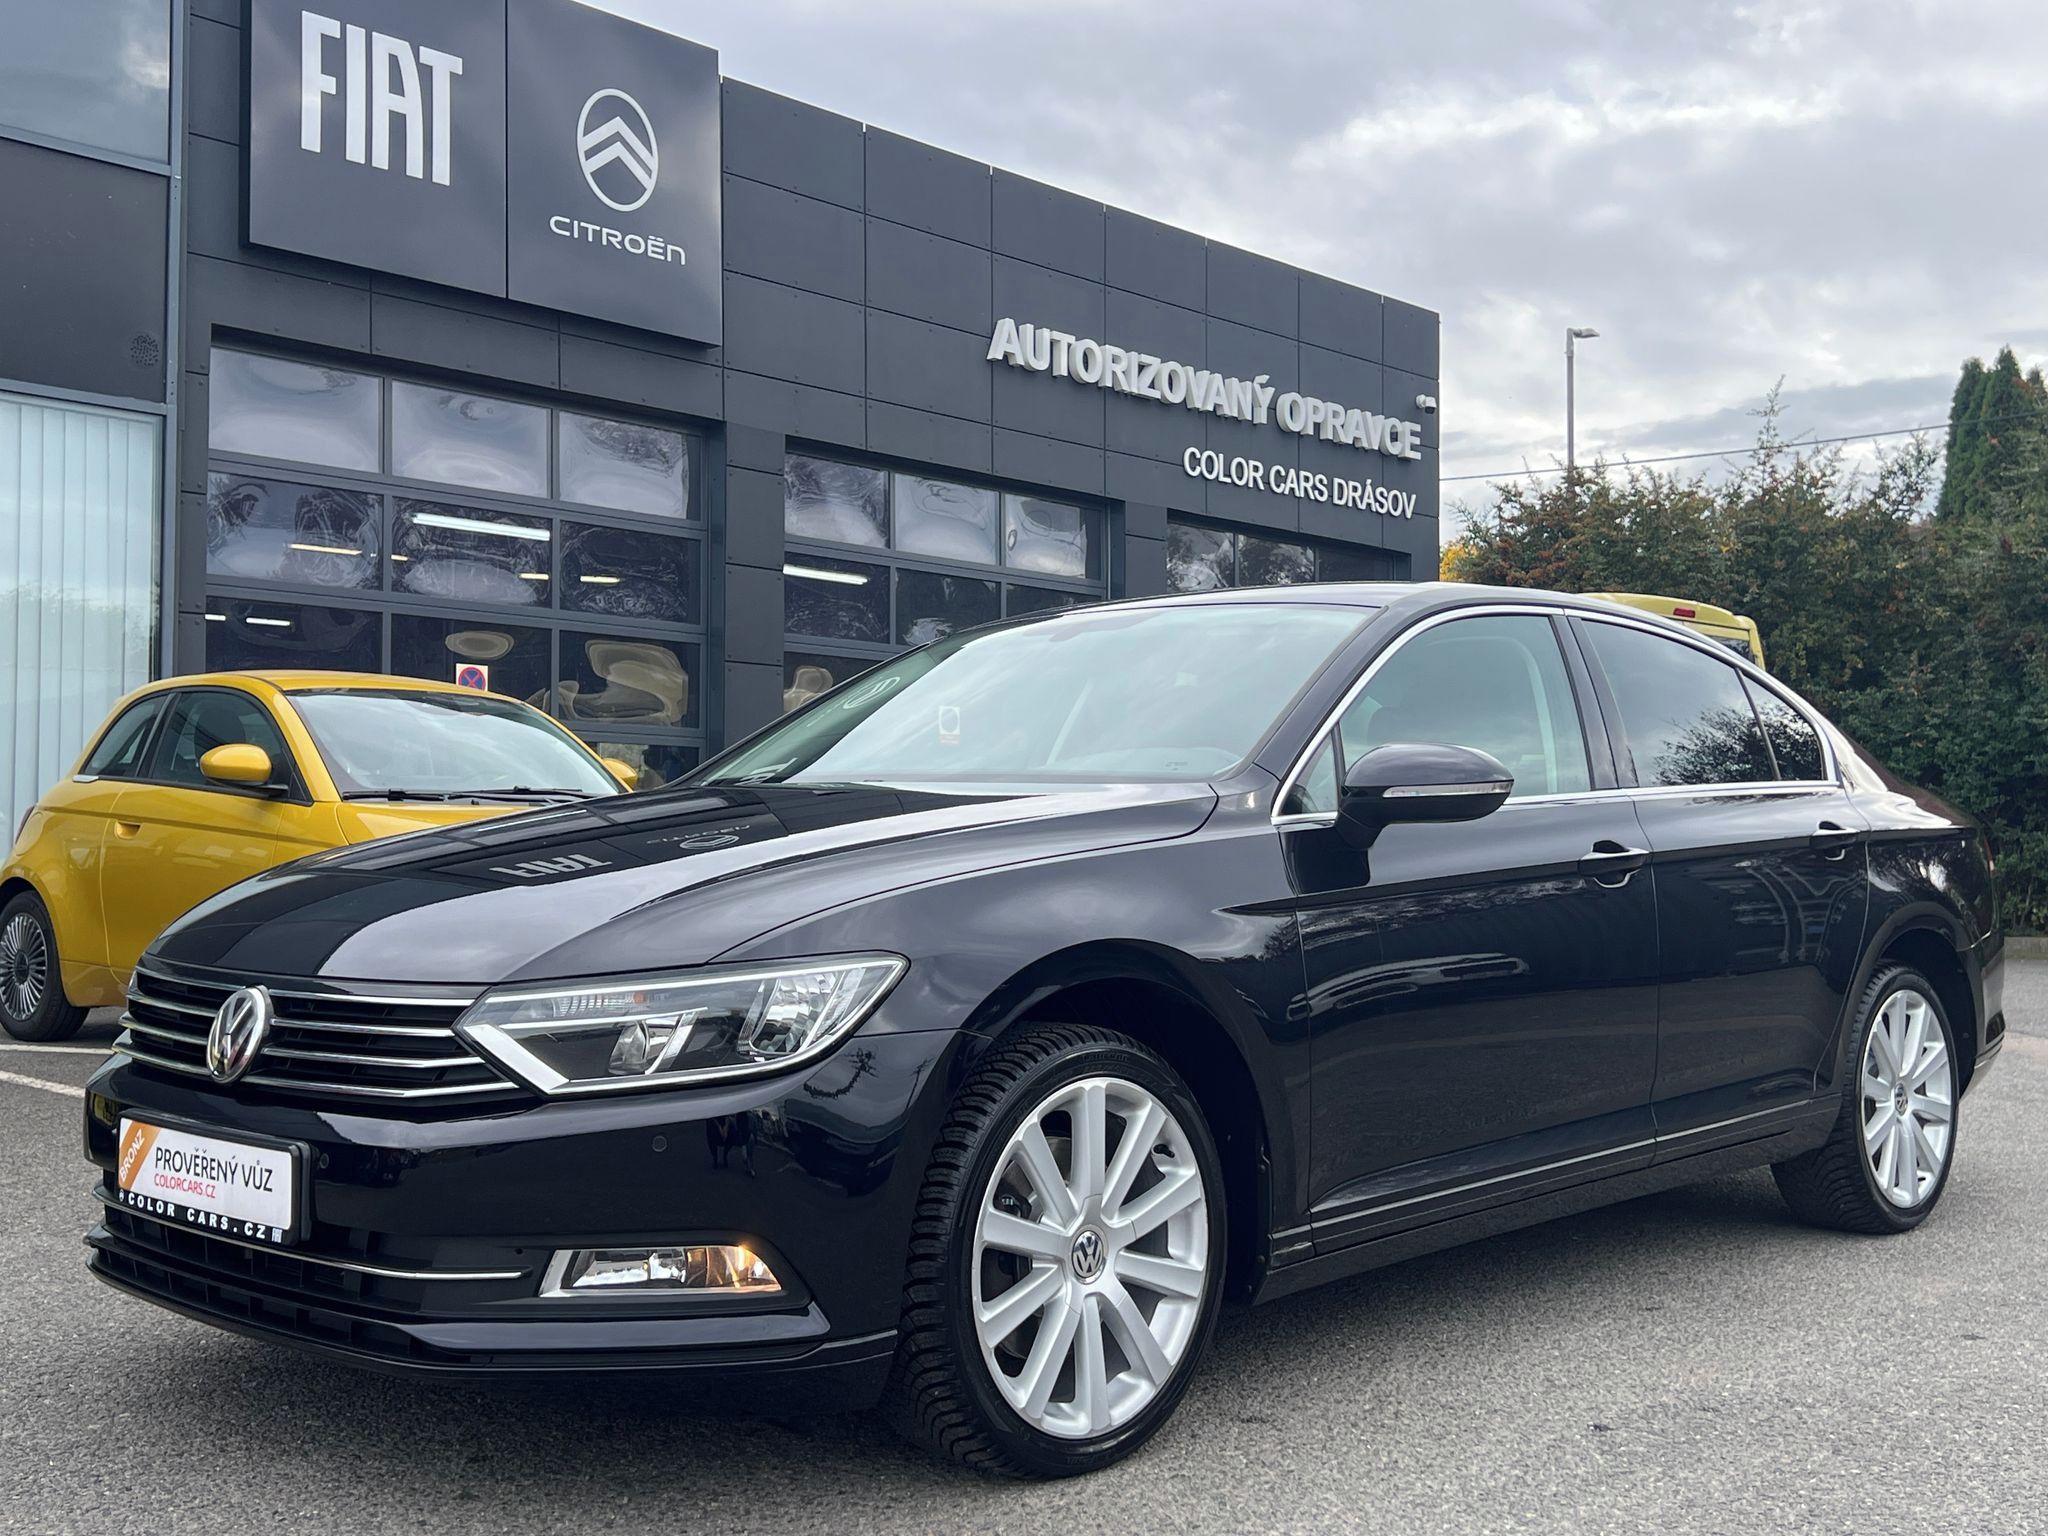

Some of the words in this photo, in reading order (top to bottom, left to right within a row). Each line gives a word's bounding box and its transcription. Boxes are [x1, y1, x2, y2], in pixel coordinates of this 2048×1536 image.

[301, 10, 463, 186] FIAT
[986, 317, 1275, 424] AUTORIZOVANÝ
[1275, 392, 1422, 460] OPRAVCE
[1183, 447, 1263, 490] COLOR
[1269, 464, 1328, 503] CARS
[1332, 479, 1417, 519] DRÁSOV
[119, 1128, 145, 1182] BRONZ
[155, 1147, 238, 1185] PROVĚŘENÝ
[242, 1159, 273, 1193] VŮZ
[154, 1173, 216, 1199] COLORCARS.CZ
[128, 1191, 175, 1217] COLOR
[187, 1208, 266, 1239] CARS.CZ
